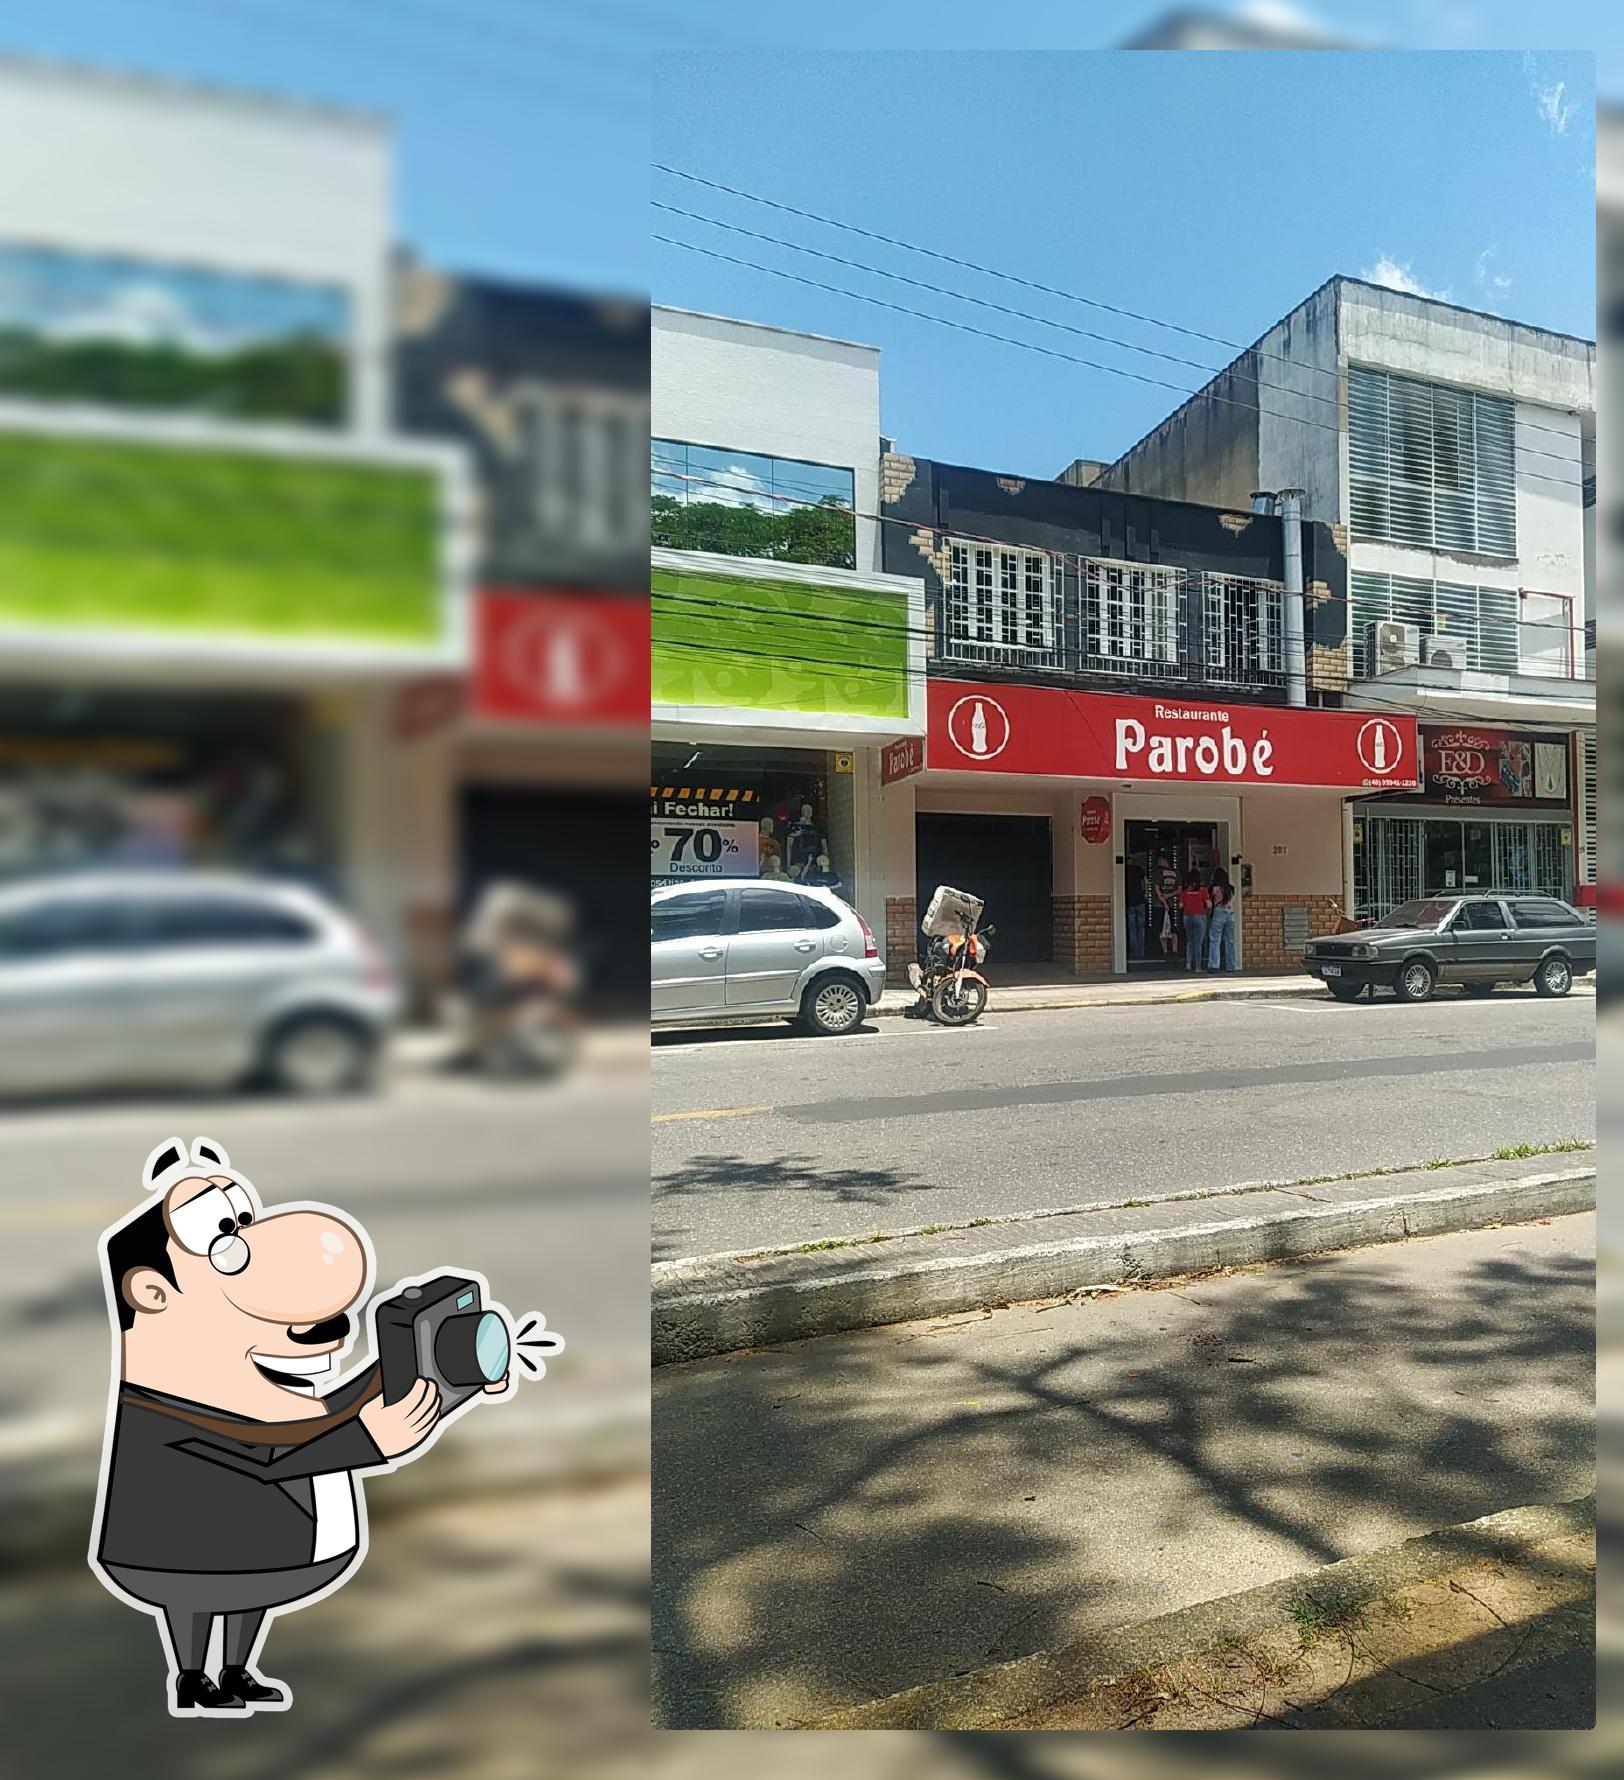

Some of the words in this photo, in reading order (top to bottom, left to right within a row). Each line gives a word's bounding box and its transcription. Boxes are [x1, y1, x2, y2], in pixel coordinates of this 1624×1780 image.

[1155, 704, 1229, 723] Restaurante
[1115, 718, 1274, 776] Parobé
[1445, 794, 1481, 804] Presentes
[664, 802, 734, 817] Fechar!
[669, 862, 723, 873] Desconto
